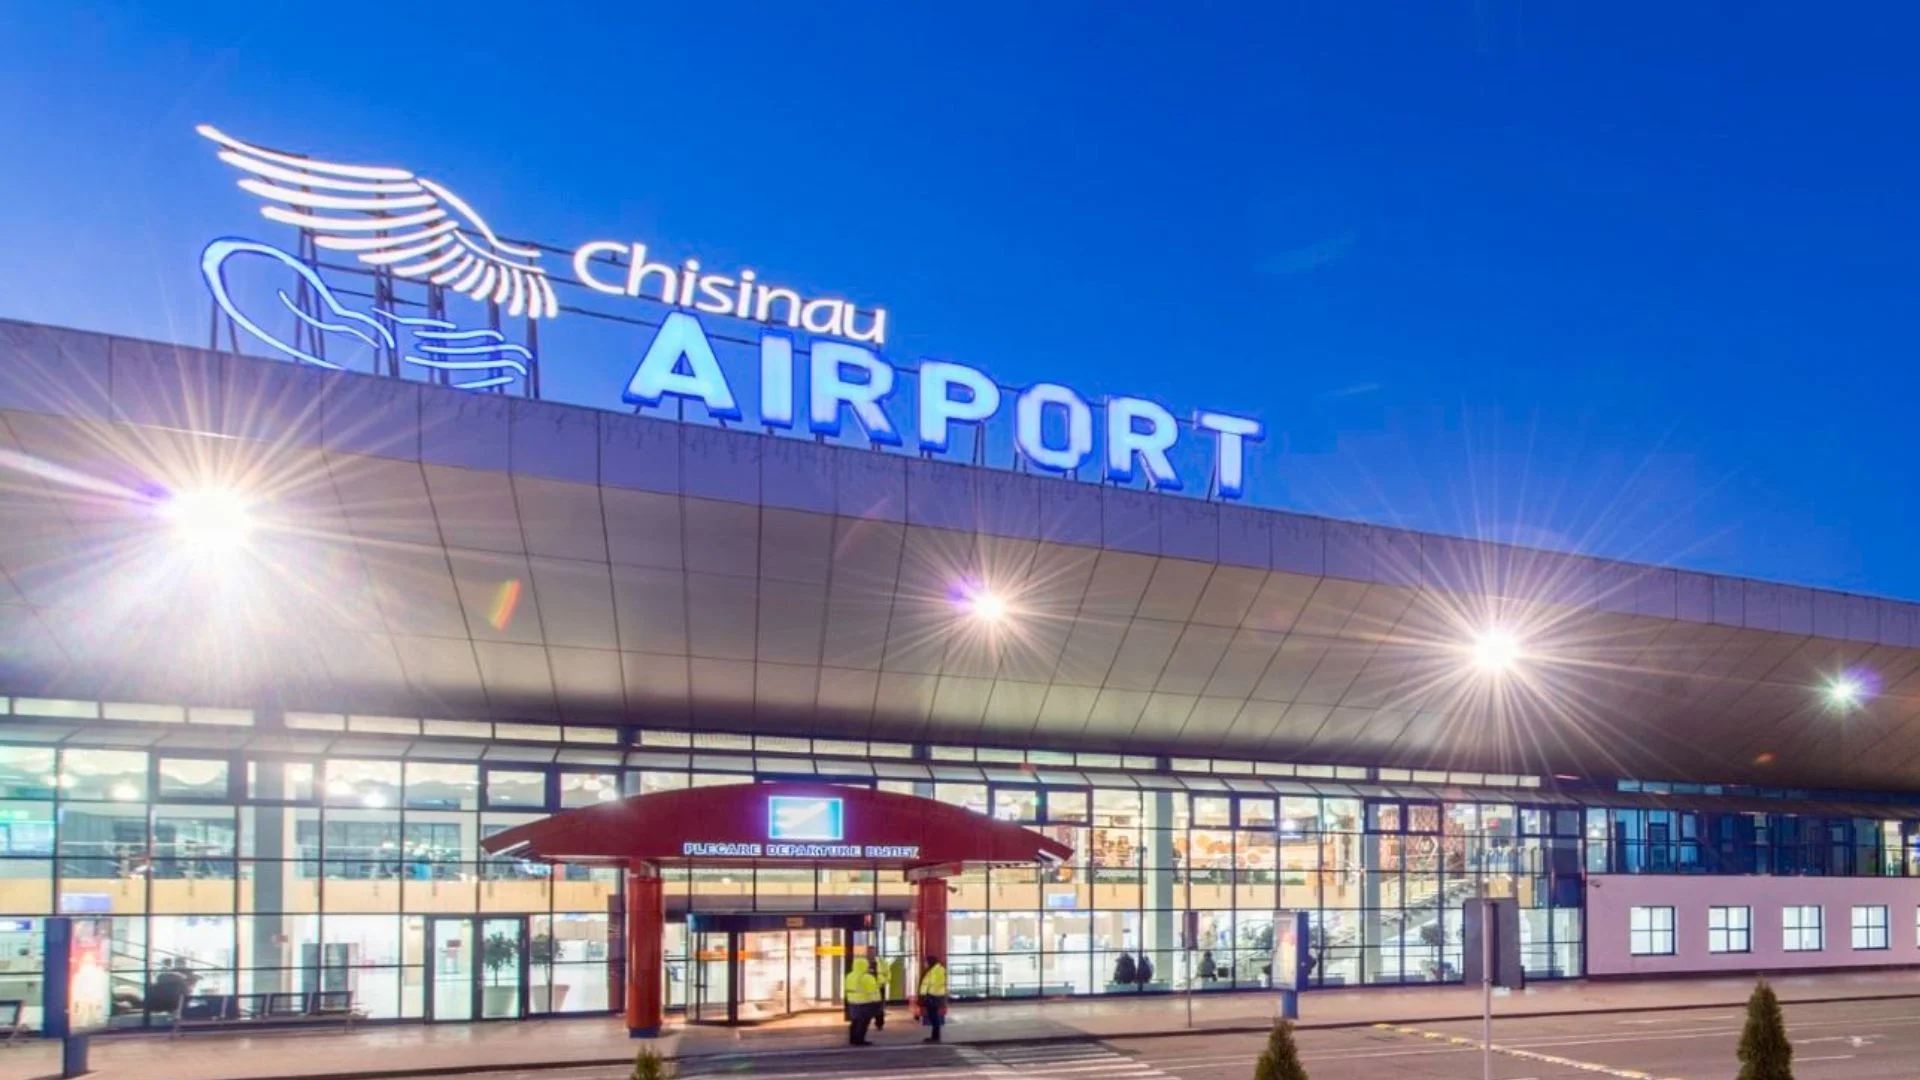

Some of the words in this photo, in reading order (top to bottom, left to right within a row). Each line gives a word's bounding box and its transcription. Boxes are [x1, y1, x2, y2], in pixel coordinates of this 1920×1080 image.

[573, 240, 886, 344] Chisinau
[622, 311, 1265, 498] AIRPORT
[683, 843, 761, 856] PLECARE
[766, 844, 862, 857] DEPARTURE
